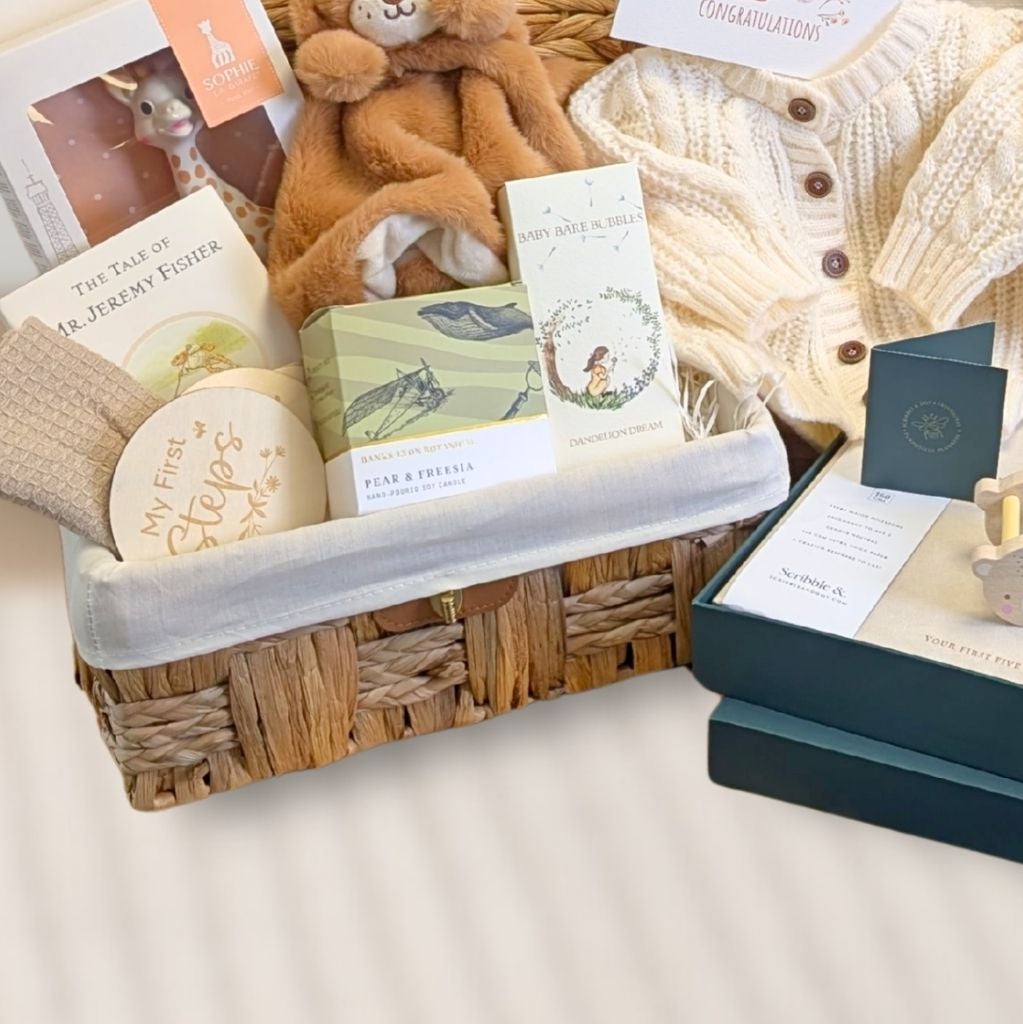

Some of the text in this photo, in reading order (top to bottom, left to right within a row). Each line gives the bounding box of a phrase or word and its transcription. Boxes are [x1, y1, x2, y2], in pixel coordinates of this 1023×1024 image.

[202, 58, 260, 92] SOPHIE
[518, 213, 644, 244] BABY BARE BUBBLES
[71, 237, 171, 296] THE TALE OF
[87, 275, 155, 323] JEREMY
[156, 240, 222, 281] FISHER
[569, 421, 663, 448] DANDELION DREAM
[140, 437, 186, 537] My First
[167, 421, 254, 556] Steps
[364, 462, 475, 489] PEAR & FREESIA
[779, 567, 831, 592] Scribble
[924, 634, 957, 650] YOUR
[959, 645, 992, 661] FIRST
[994, 656, 1022, 670] FIVE
